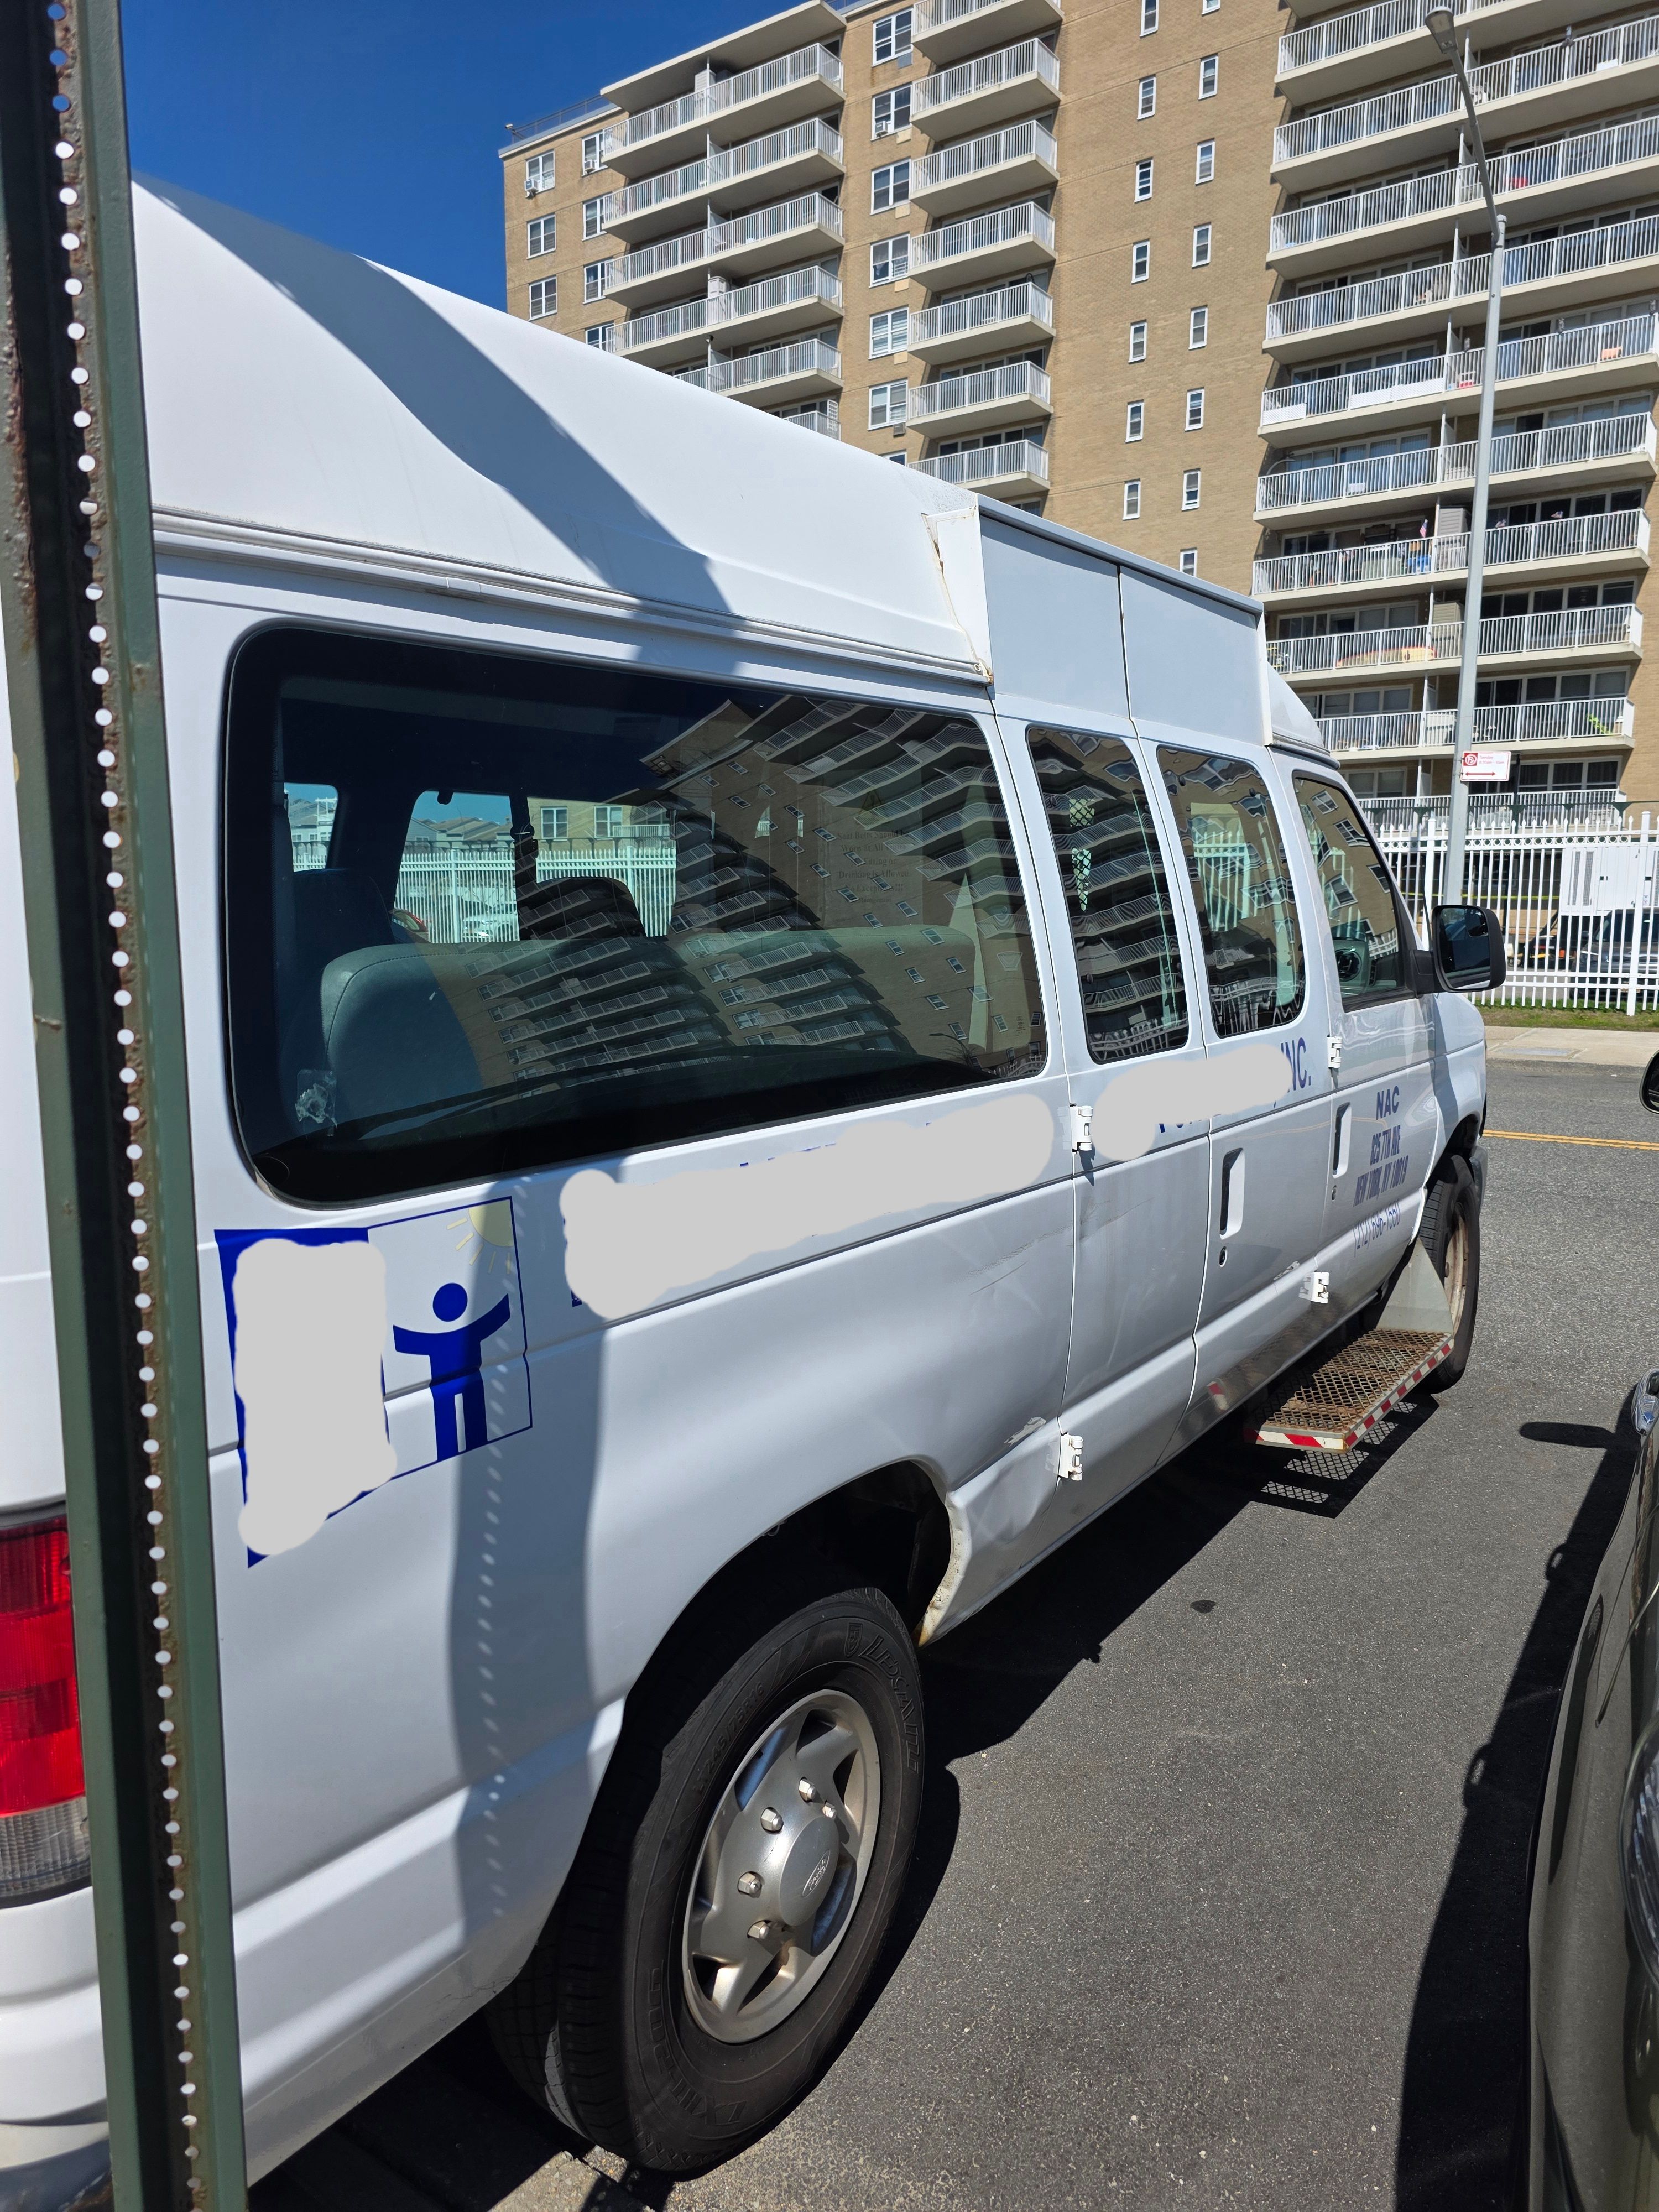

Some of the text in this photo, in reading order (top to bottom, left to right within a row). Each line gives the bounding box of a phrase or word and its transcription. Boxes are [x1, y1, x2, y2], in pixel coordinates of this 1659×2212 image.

[855, 830, 873, 839] Belts
[874, 830, 898, 839] Should
[1281, 1037, 1311, 1093] NC.
[1376, 1086, 1400, 1120] NAC
[1391, 1124, 1401, 1157] AVE
